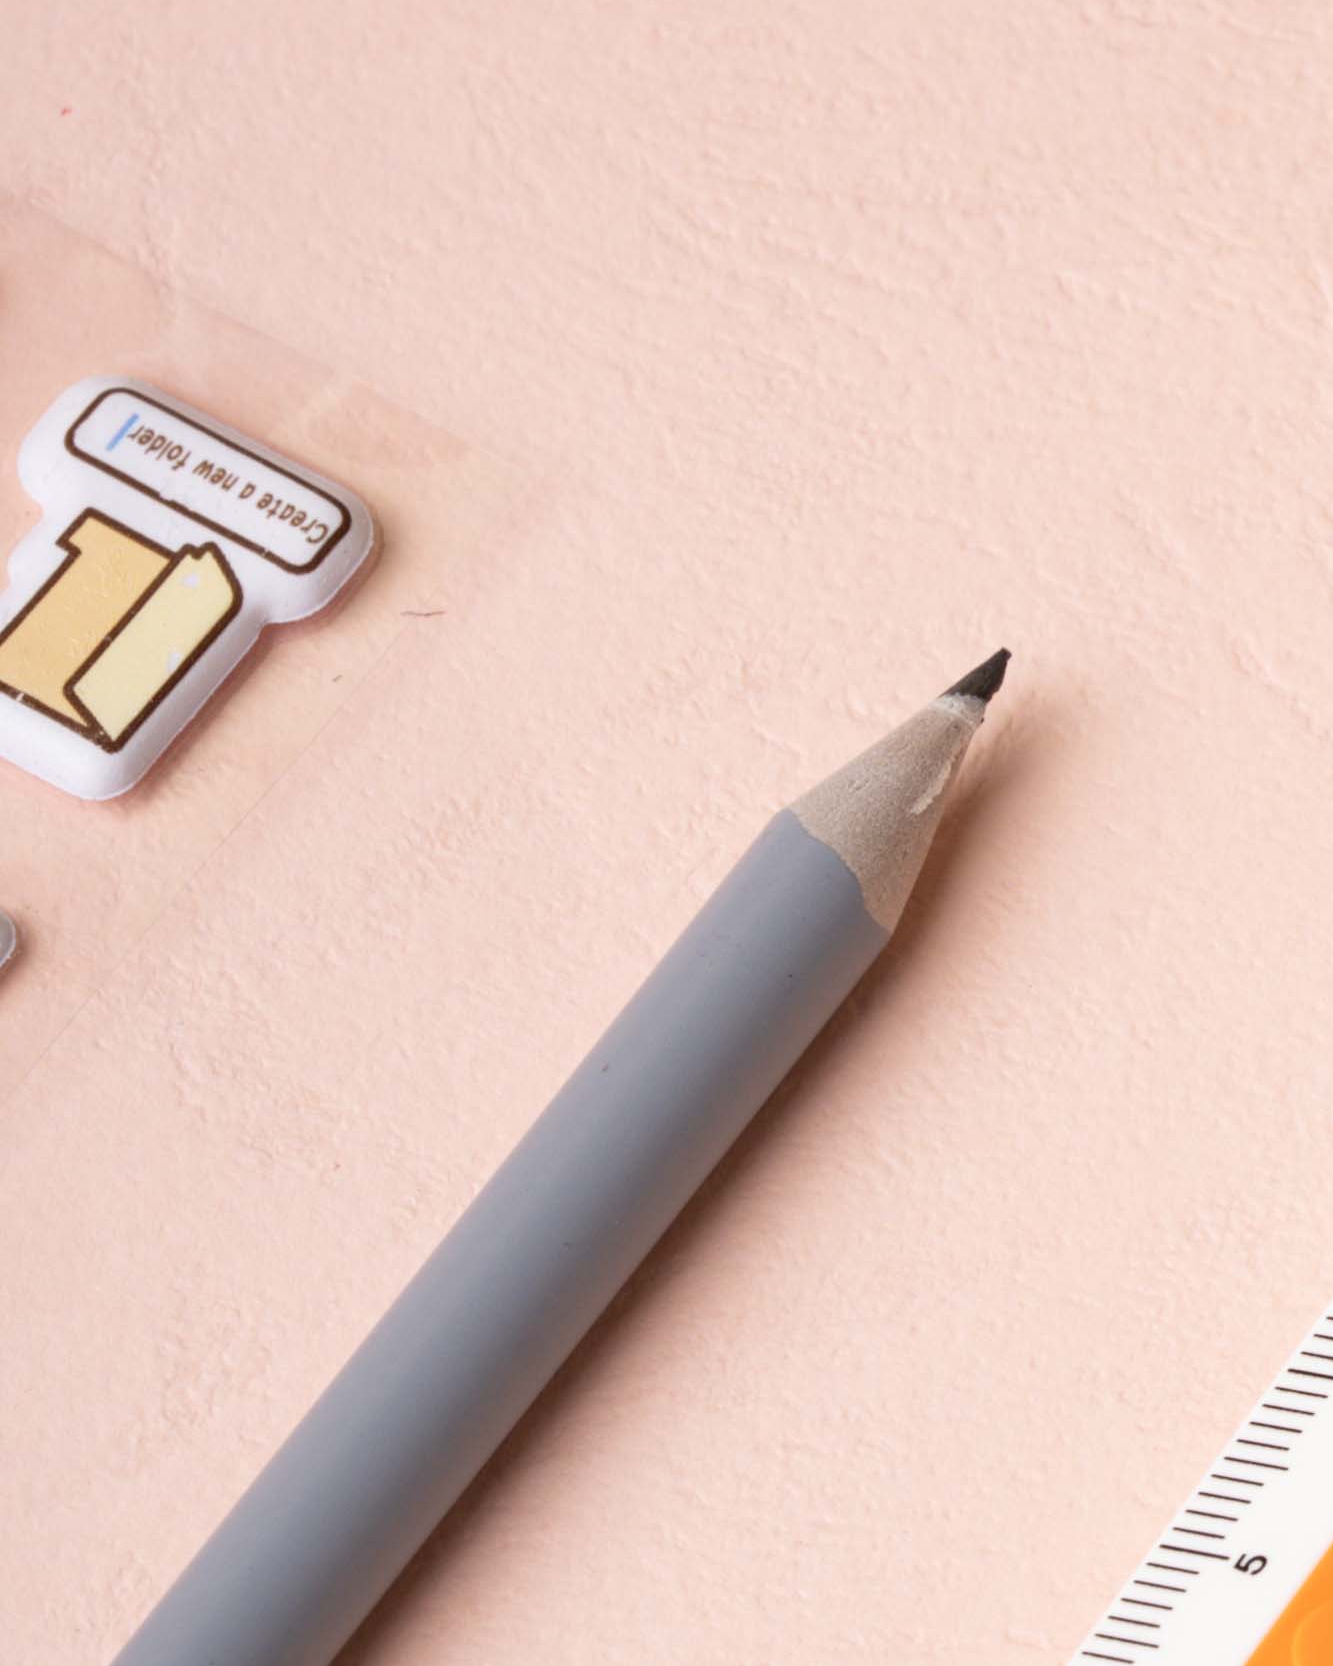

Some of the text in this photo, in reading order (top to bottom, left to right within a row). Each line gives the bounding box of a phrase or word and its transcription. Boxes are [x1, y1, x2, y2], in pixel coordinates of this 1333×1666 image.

[127, 424, 329, 545] Create a new folder
[1234, 1552, 1268, 1576] 5
